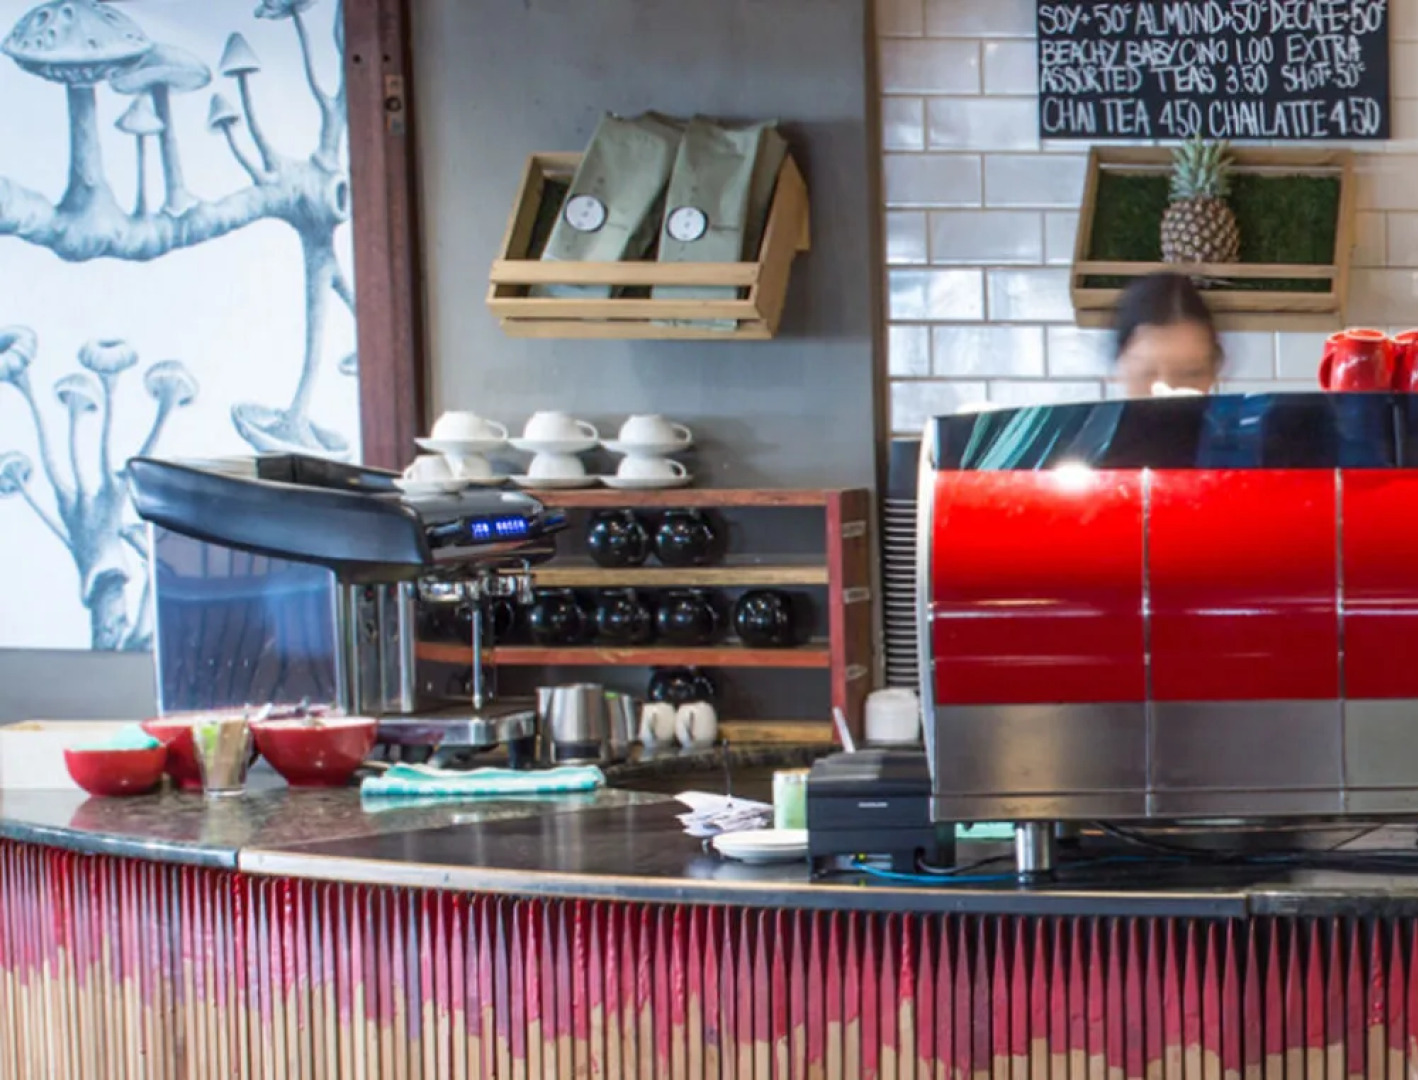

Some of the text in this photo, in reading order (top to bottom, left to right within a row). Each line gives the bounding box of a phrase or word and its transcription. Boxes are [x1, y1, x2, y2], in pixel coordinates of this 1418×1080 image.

[1041, 38, 1121, 67] BEACHY
[1236, 36, 1274, 64] 1.00
[1286, 33, 1361, 64] EXTRA
[1040, 64, 1269, 95] ASSORTED TEAS 3.50
[1042, 97, 1097, 133] CHAI
[1101, 98, 1150, 136] TEA
